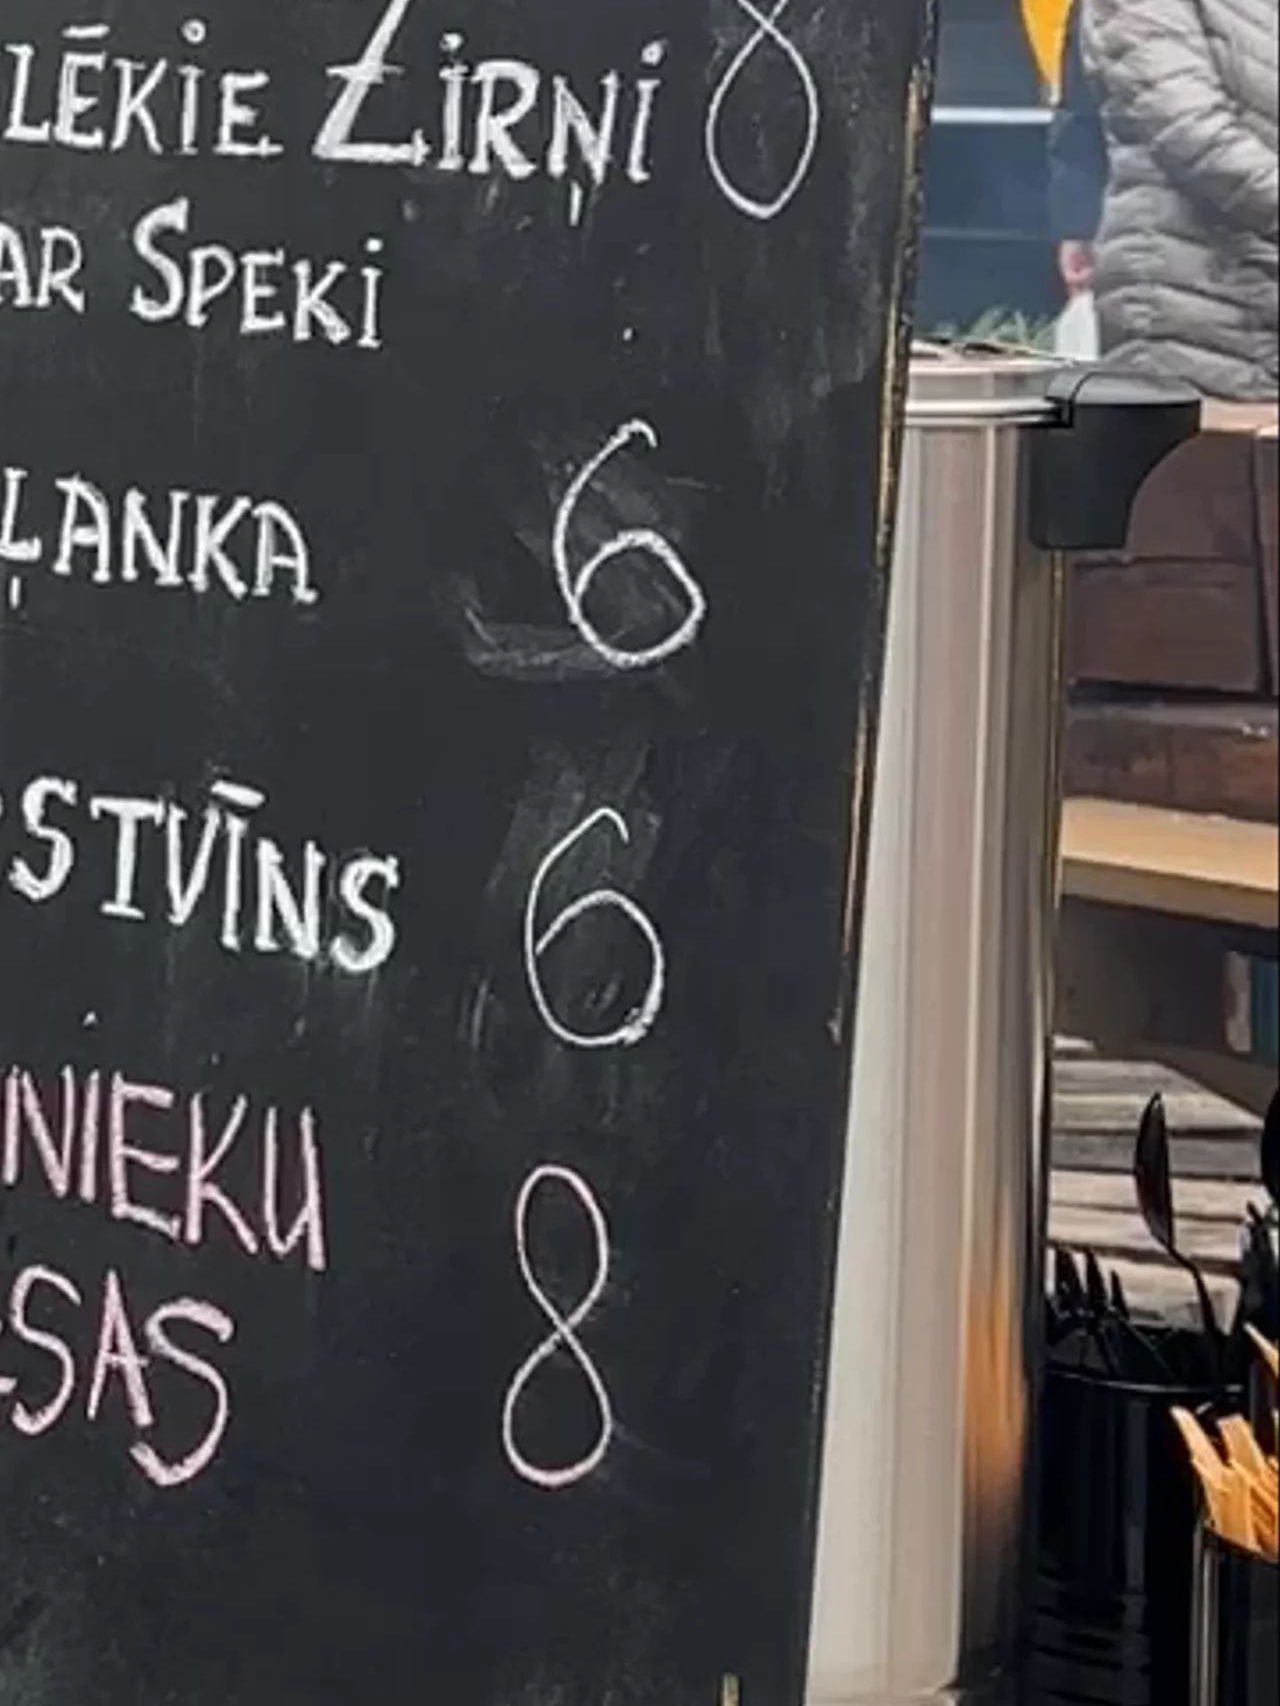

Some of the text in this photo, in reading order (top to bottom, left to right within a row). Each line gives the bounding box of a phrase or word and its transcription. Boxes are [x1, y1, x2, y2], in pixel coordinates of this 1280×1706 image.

[552, 418, 706, 668] 6
[524, 806, 665, 1047] 6
[502, 1164, 614, 1487] 8
